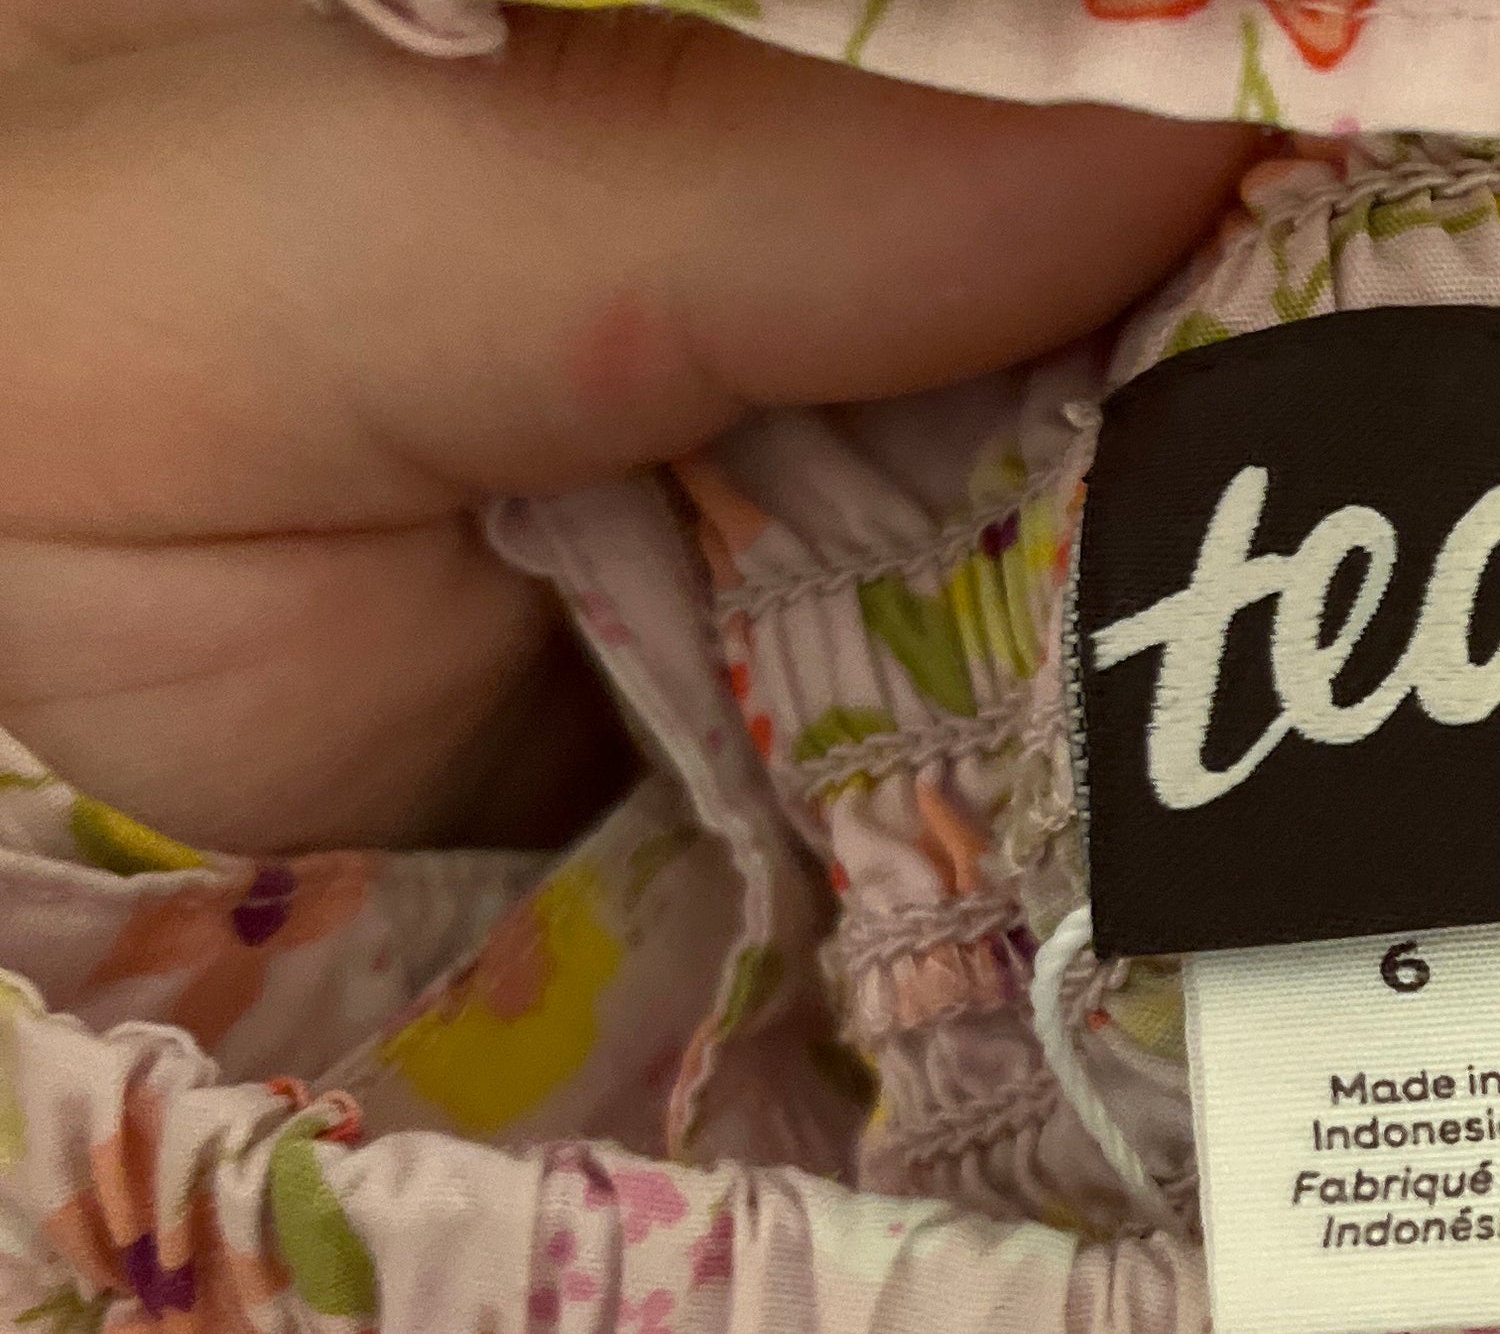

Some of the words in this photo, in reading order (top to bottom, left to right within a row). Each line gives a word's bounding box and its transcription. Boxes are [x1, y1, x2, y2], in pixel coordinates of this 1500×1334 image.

[1379, 940, 1431, 993] 6
[1330, 1070, 1456, 1105] Made
[1292, 1160, 1494, 1206] Fabriqué
